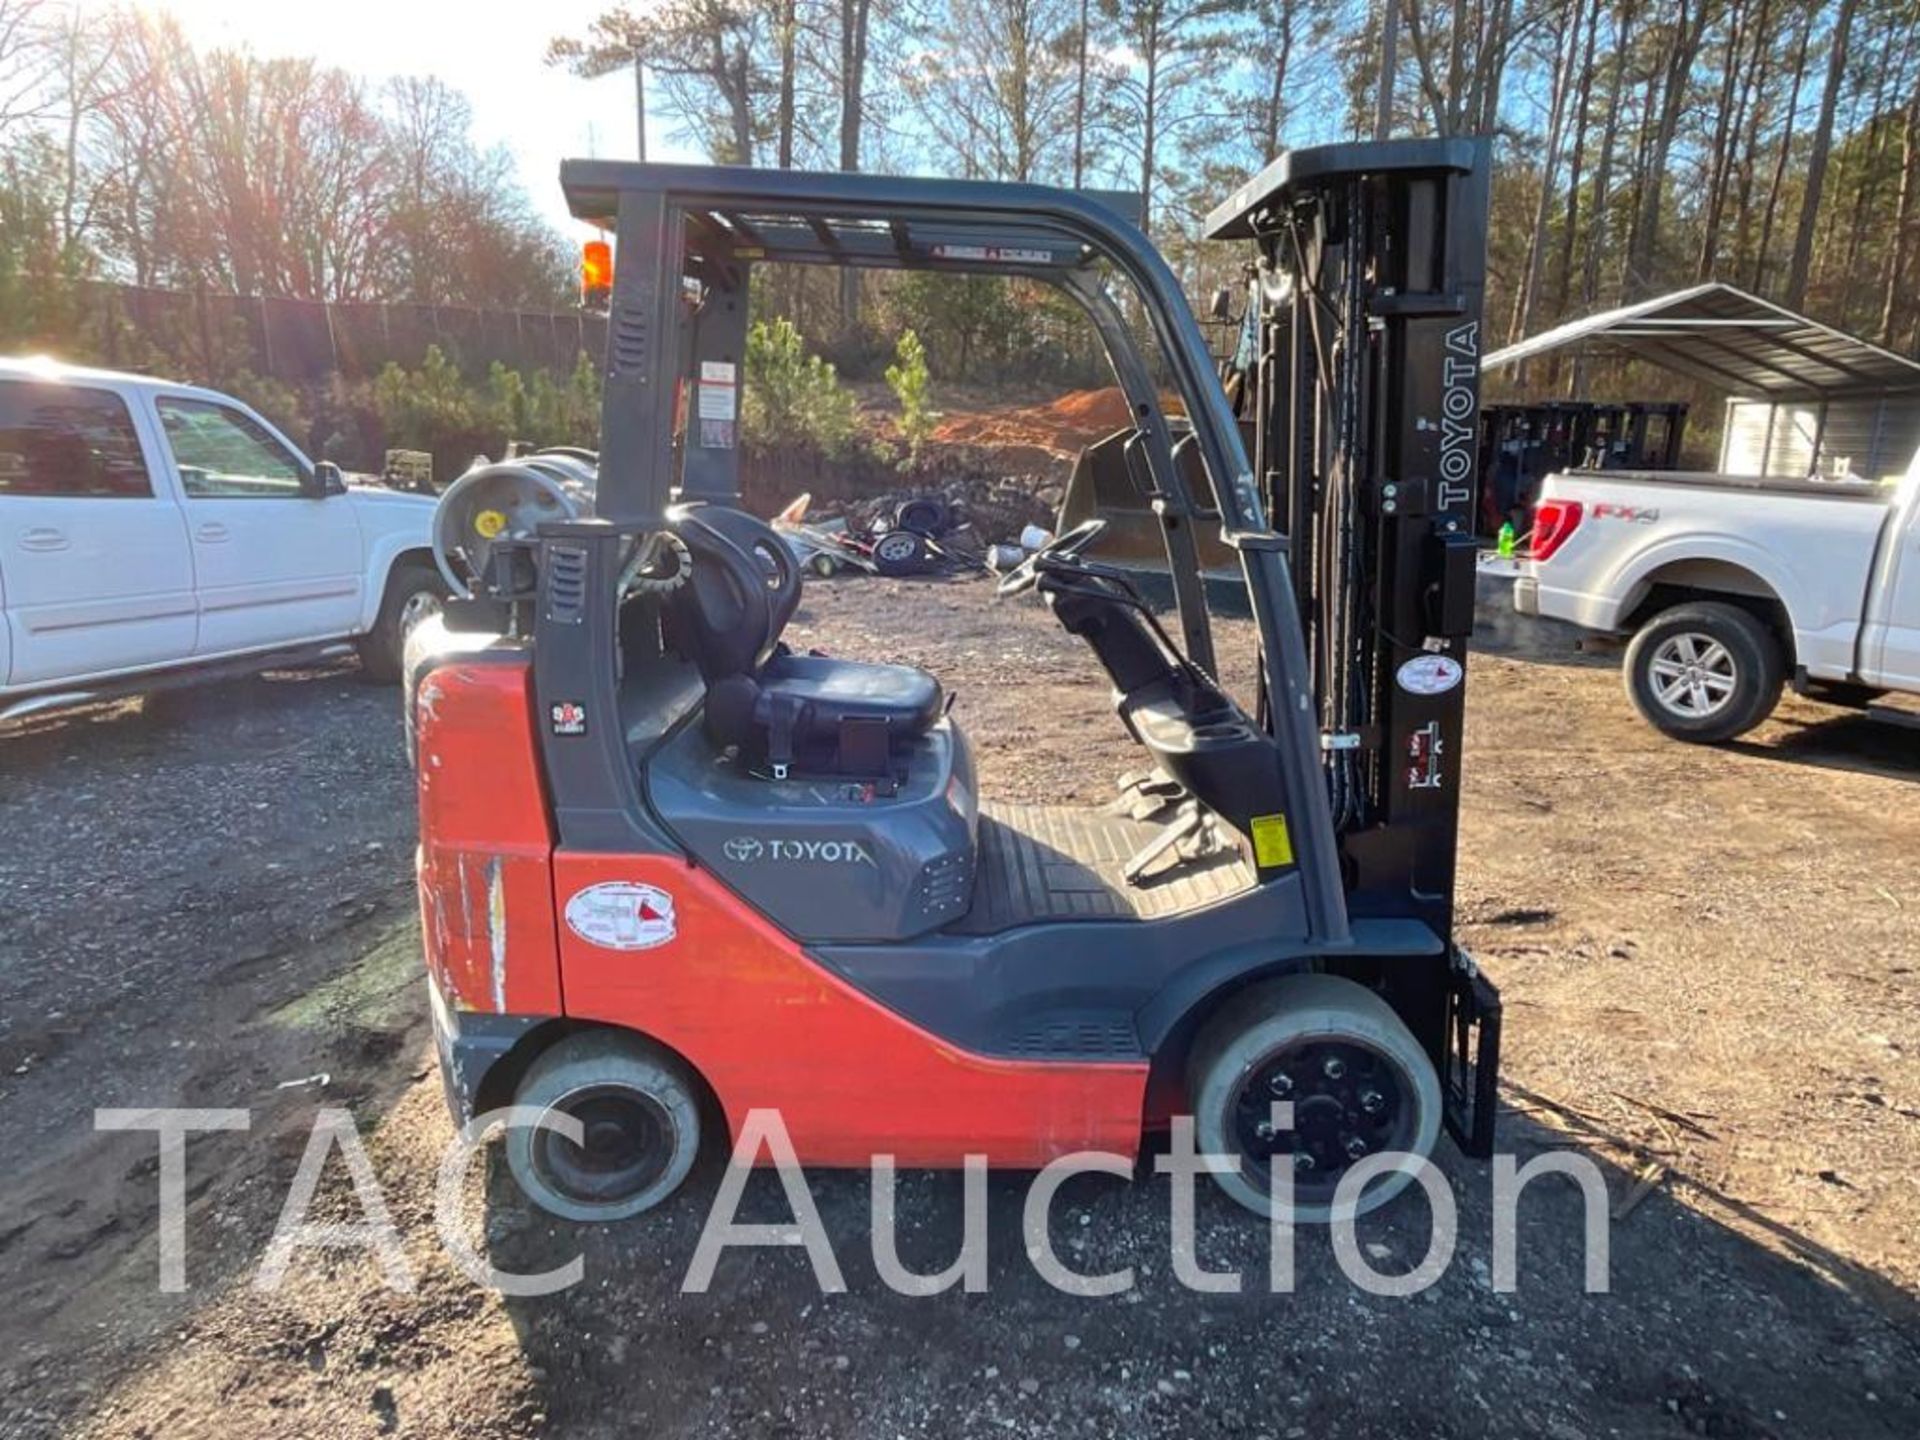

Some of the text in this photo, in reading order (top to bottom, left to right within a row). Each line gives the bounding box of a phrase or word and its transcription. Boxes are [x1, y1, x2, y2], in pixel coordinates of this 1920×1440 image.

[1438, 321, 1478, 511] TOYOTA
[1592, 504, 1660, 525] FX4
[769, 839, 877, 865] TOYOTA
